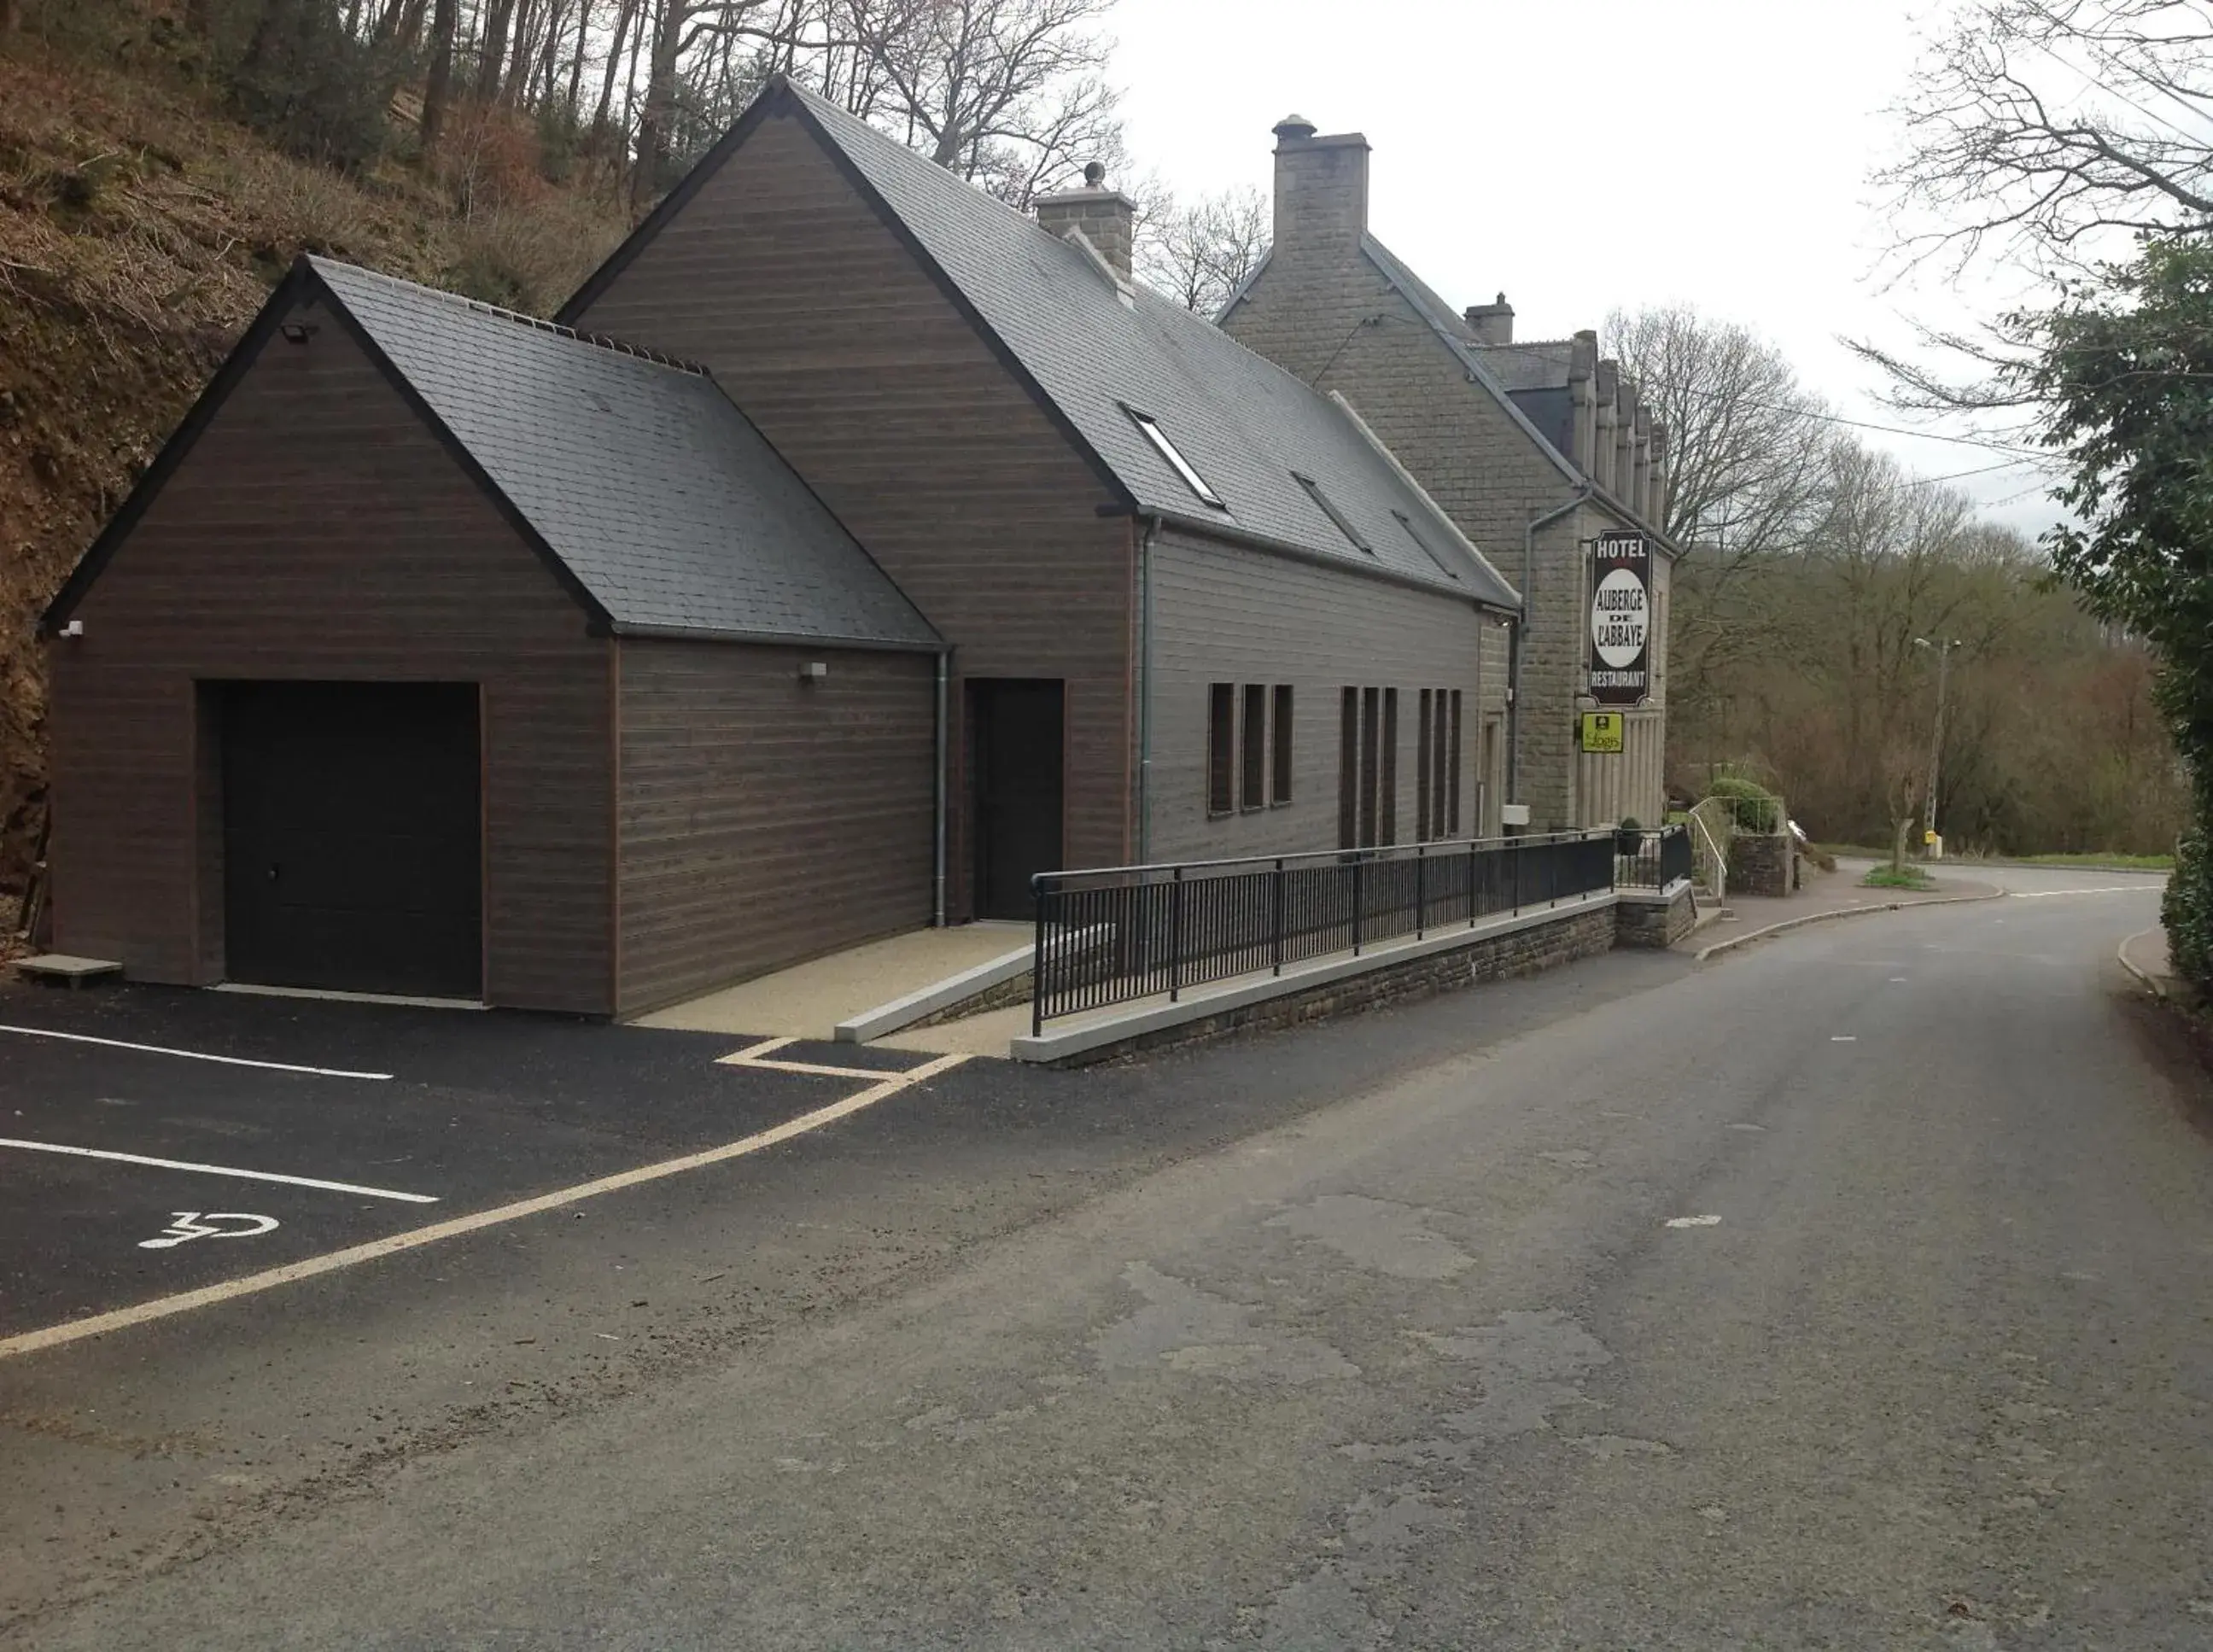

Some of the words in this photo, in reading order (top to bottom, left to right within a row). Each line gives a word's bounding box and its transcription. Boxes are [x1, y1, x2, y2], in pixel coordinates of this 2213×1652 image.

[1597, 540, 1646, 558] HOTEL
[1597, 589, 1643, 610] AUBERGE
[1598, 625, 1643, 646] L'ABBAYE
[1591, 671, 1645, 686] RESTAURANT
